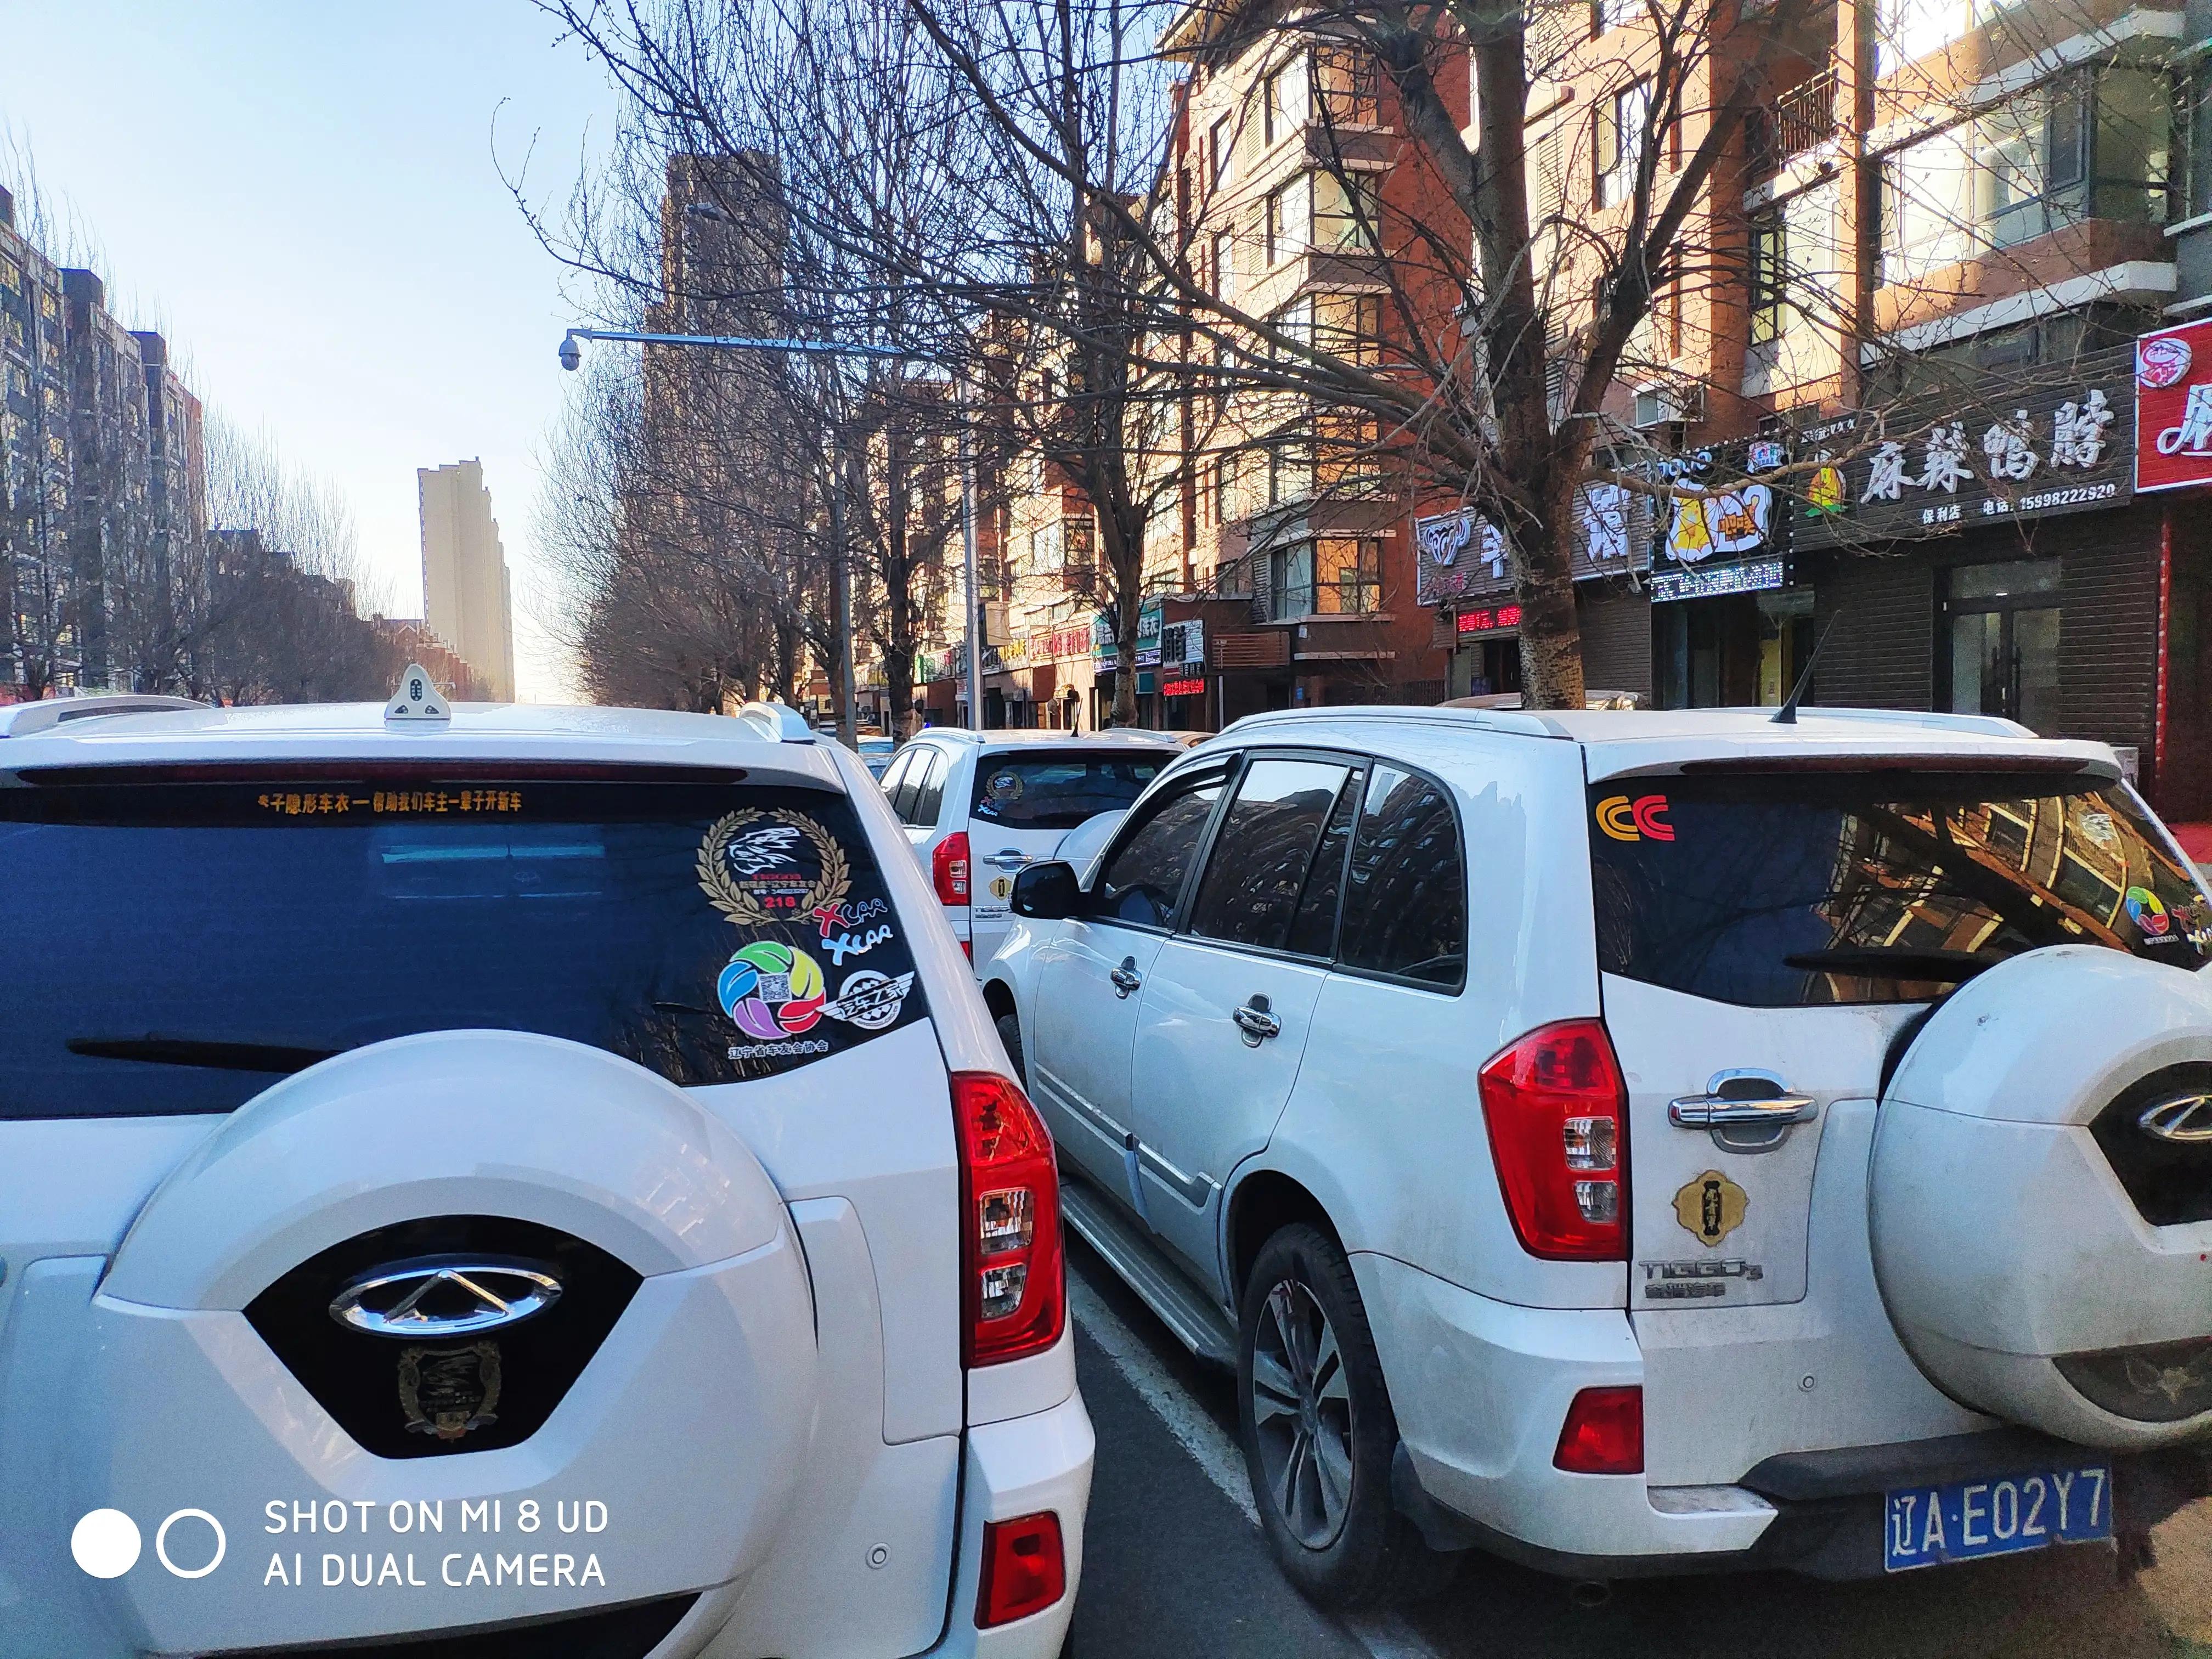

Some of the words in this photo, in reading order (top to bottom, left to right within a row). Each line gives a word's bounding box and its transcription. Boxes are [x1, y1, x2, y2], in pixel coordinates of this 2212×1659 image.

[1922, 504, 1962, 524] 保利店
[728, 1040, 829, 1060] 辽宁省车友会协会
